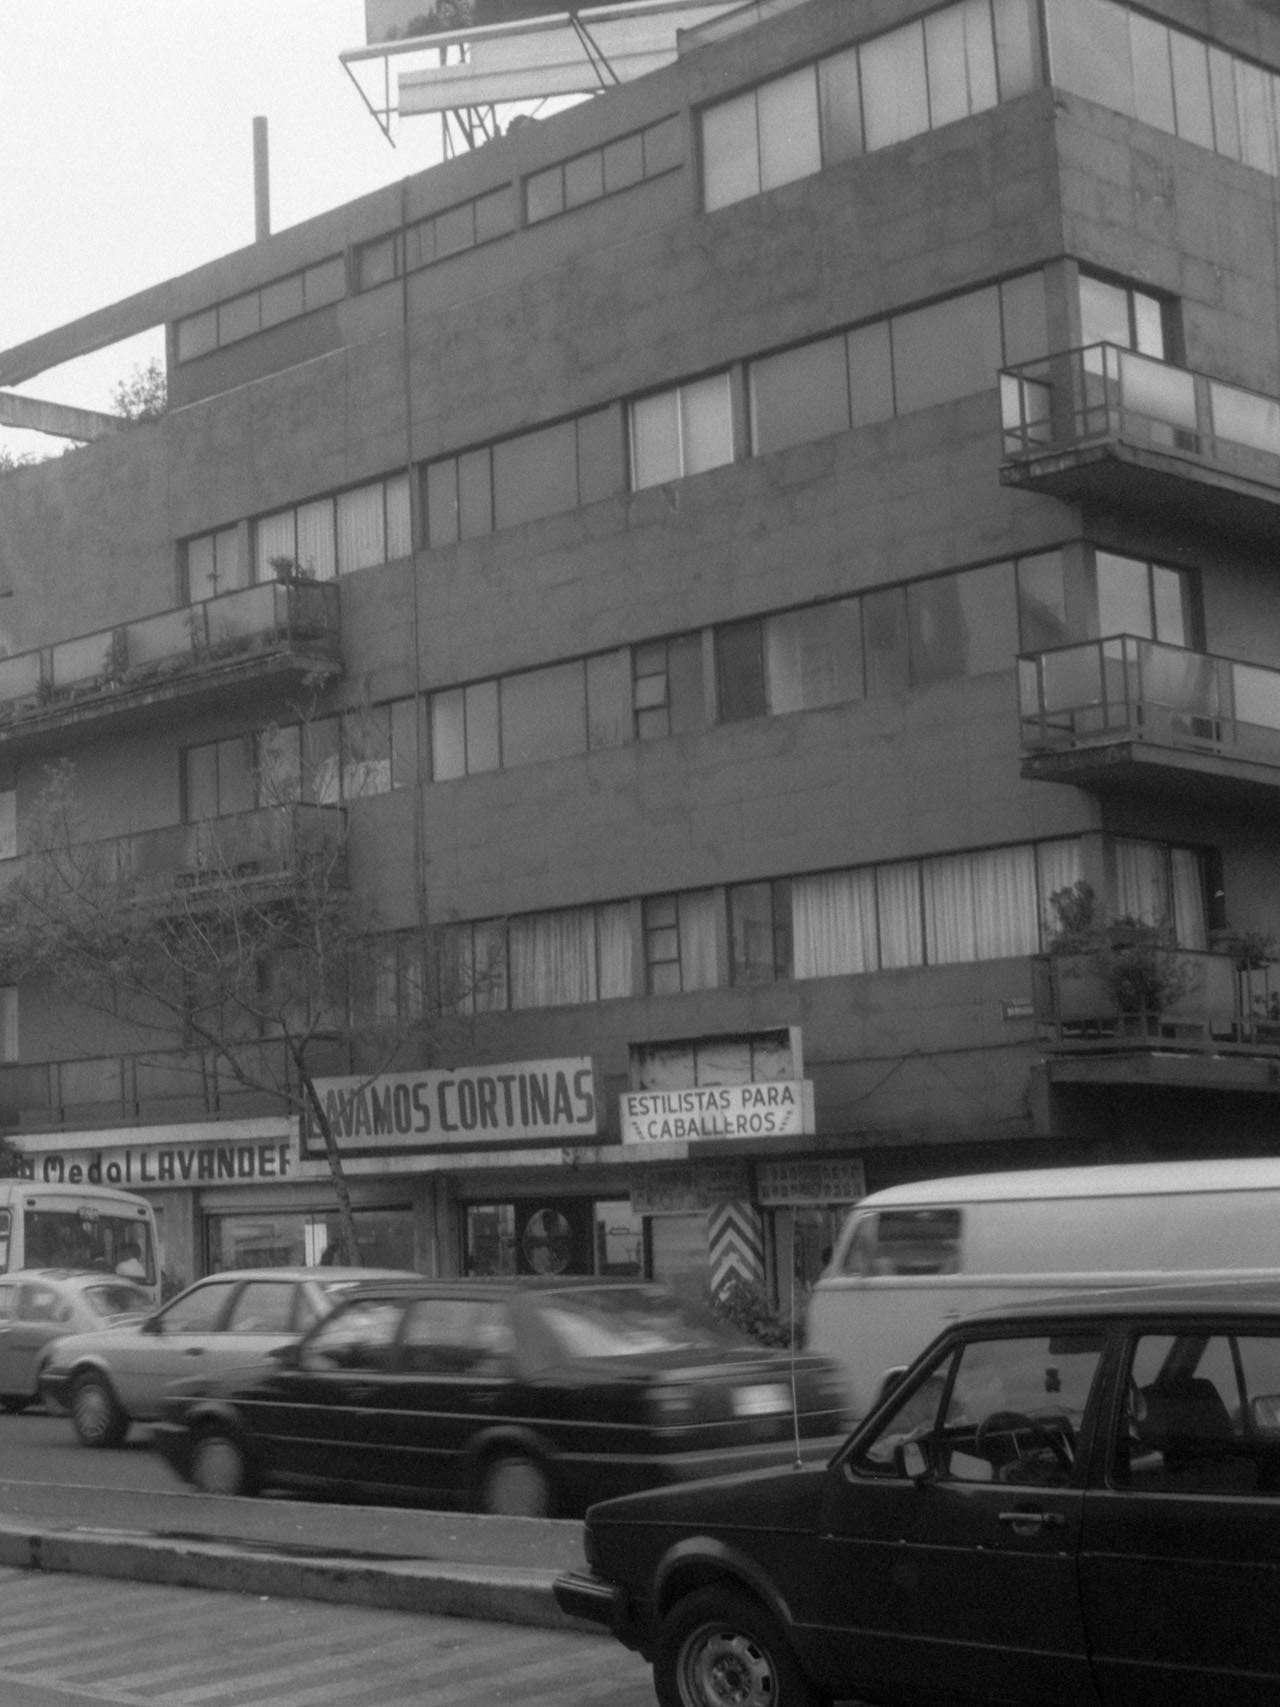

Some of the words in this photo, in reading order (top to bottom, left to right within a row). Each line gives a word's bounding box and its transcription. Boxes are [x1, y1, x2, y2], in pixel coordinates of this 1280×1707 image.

[306, 1081, 431, 1140] LAVAMOS
[437, 1068, 594, 1133] CORTINAS
[626, 1089, 731, 1117] ESTILISTAS
[740, 1085, 795, 1109] PARA
[646, 1111, 776, 1140] CABALLEROS
